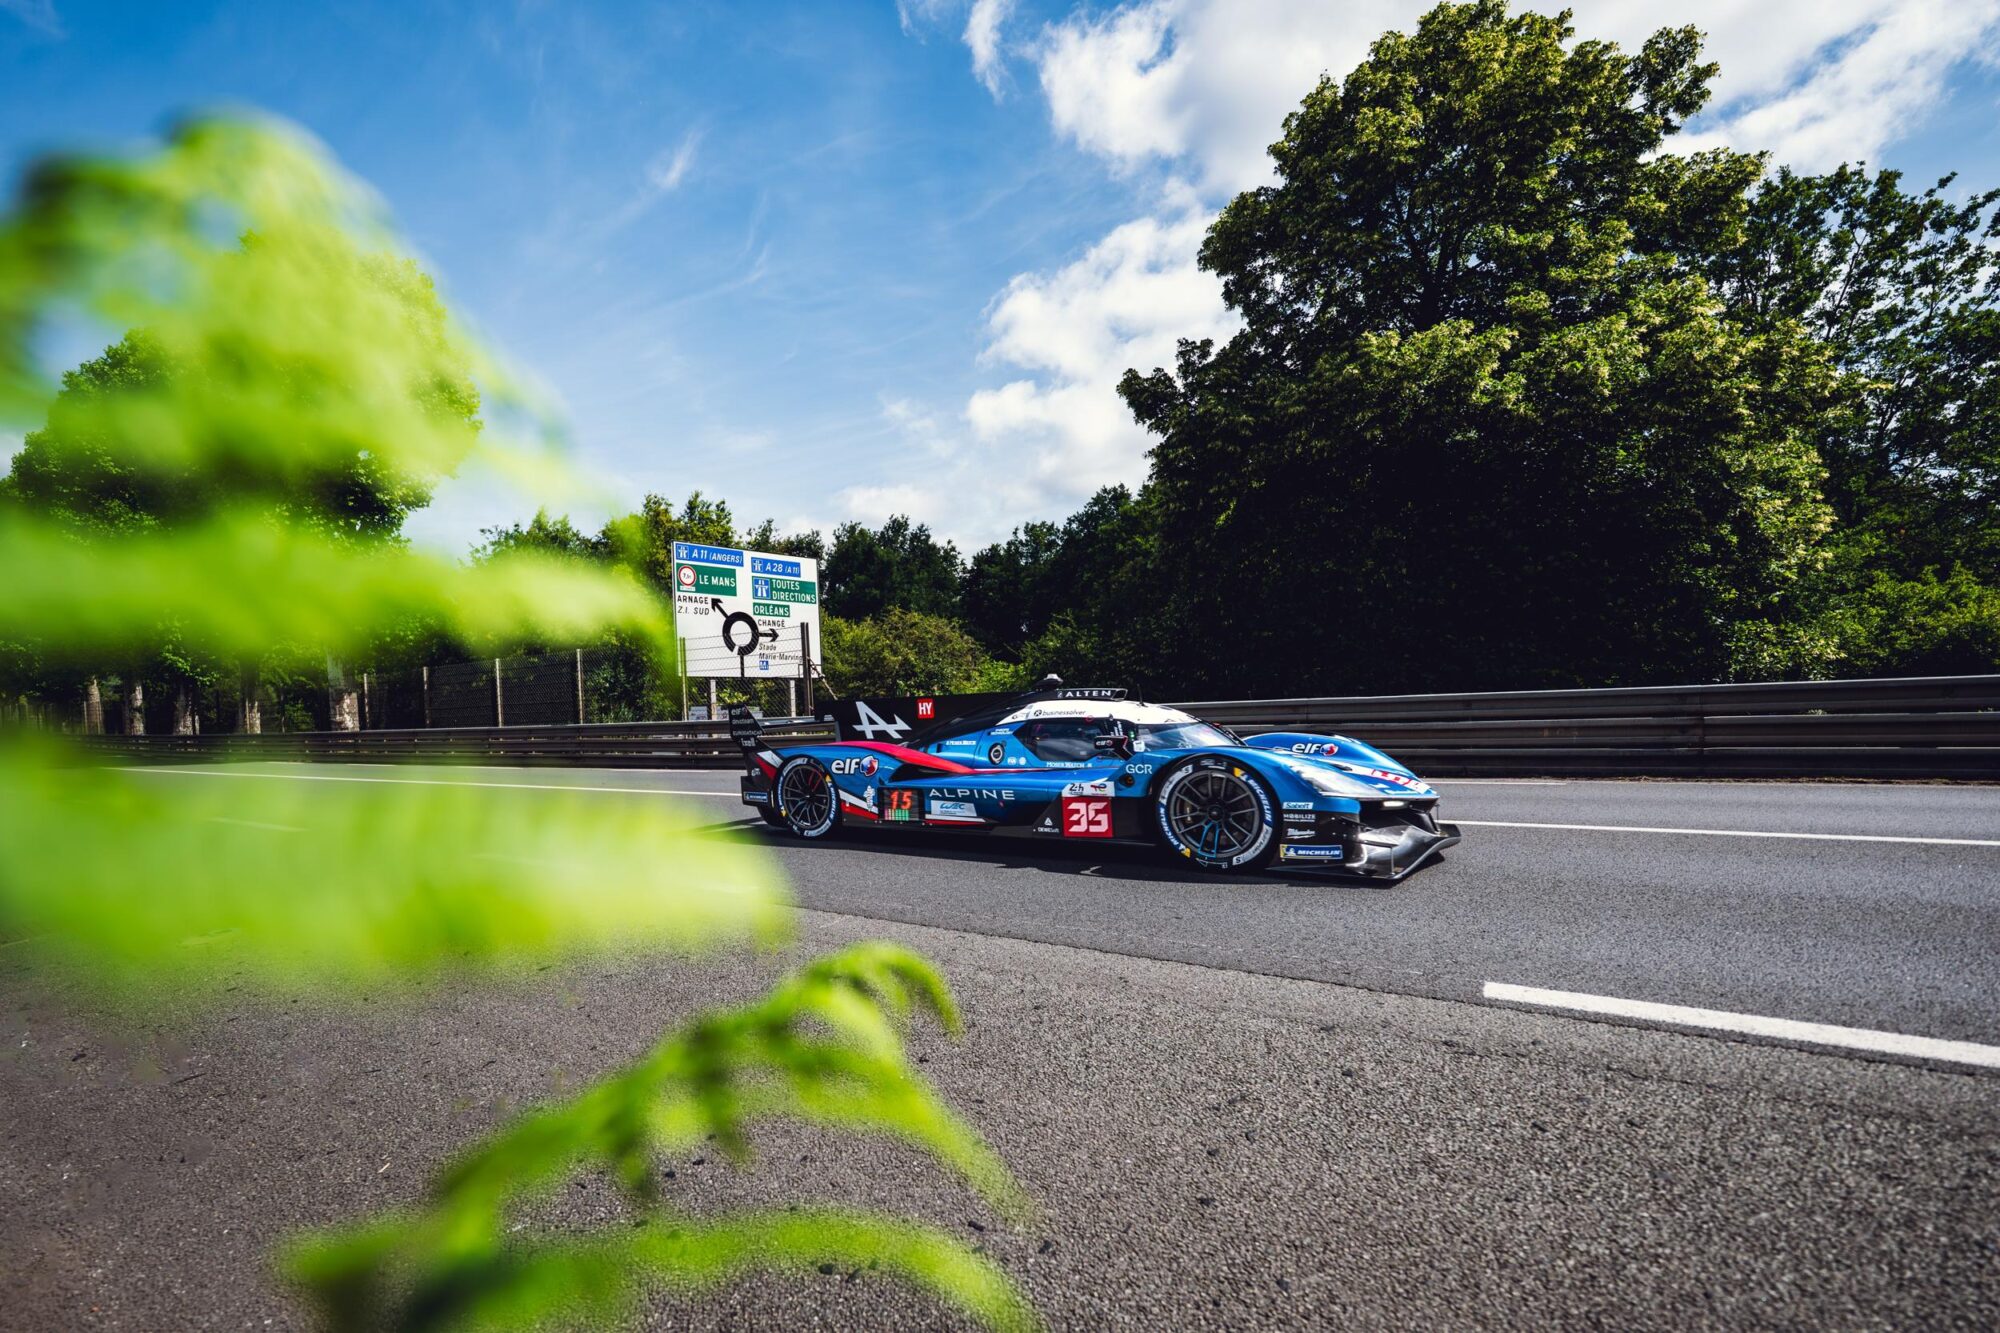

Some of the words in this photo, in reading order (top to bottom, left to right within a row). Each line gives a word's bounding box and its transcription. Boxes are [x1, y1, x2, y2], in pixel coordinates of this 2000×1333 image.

[692, 549, 698, 559] A
[701, 550, 708, 559] 11
[709, 552, 743, 564] (ANGERS)
[766, 562, 771, 572] A
[772, 563, 783, 573] 28
[785, 565, 792, 574] (A
[699, 575, 709, 585] LE
[711, 576, 736, 588] MANS
[771, 579, 800, 590] TOUTES
[677, 595, 709, 605] ARNAGE
[772, 591, 816, 603] DIRECTIONS
[677, 606, 690, 614] Z.I.
[693, 607, 710, 616] SUD
[754, 604, 789, 616] ORLÉANS
[758, 619, 785, 628] CHANGÉ
[759, 643, 777, 651] Stade
[759, 652, 804, 661] Marie-Marving
[1065, 690, 1112, 698] ALTEN
[918, 702, 932, 715] HY
[1042, 709, 1086, 717] businessolver
[1292, 743, 1321, 754] elf
[831, 758, 860, 775] elf
[1126, 764, 1153, 774] GCR
[929, 788, 1015, 800] ALPINE
[890, 791, 912, 810] 15
[1247, 779, 1272, 822] MICHELIN
[1067, 802, 1109, 832] 35
[1160, 807, 1179, 846] MICHELIN
